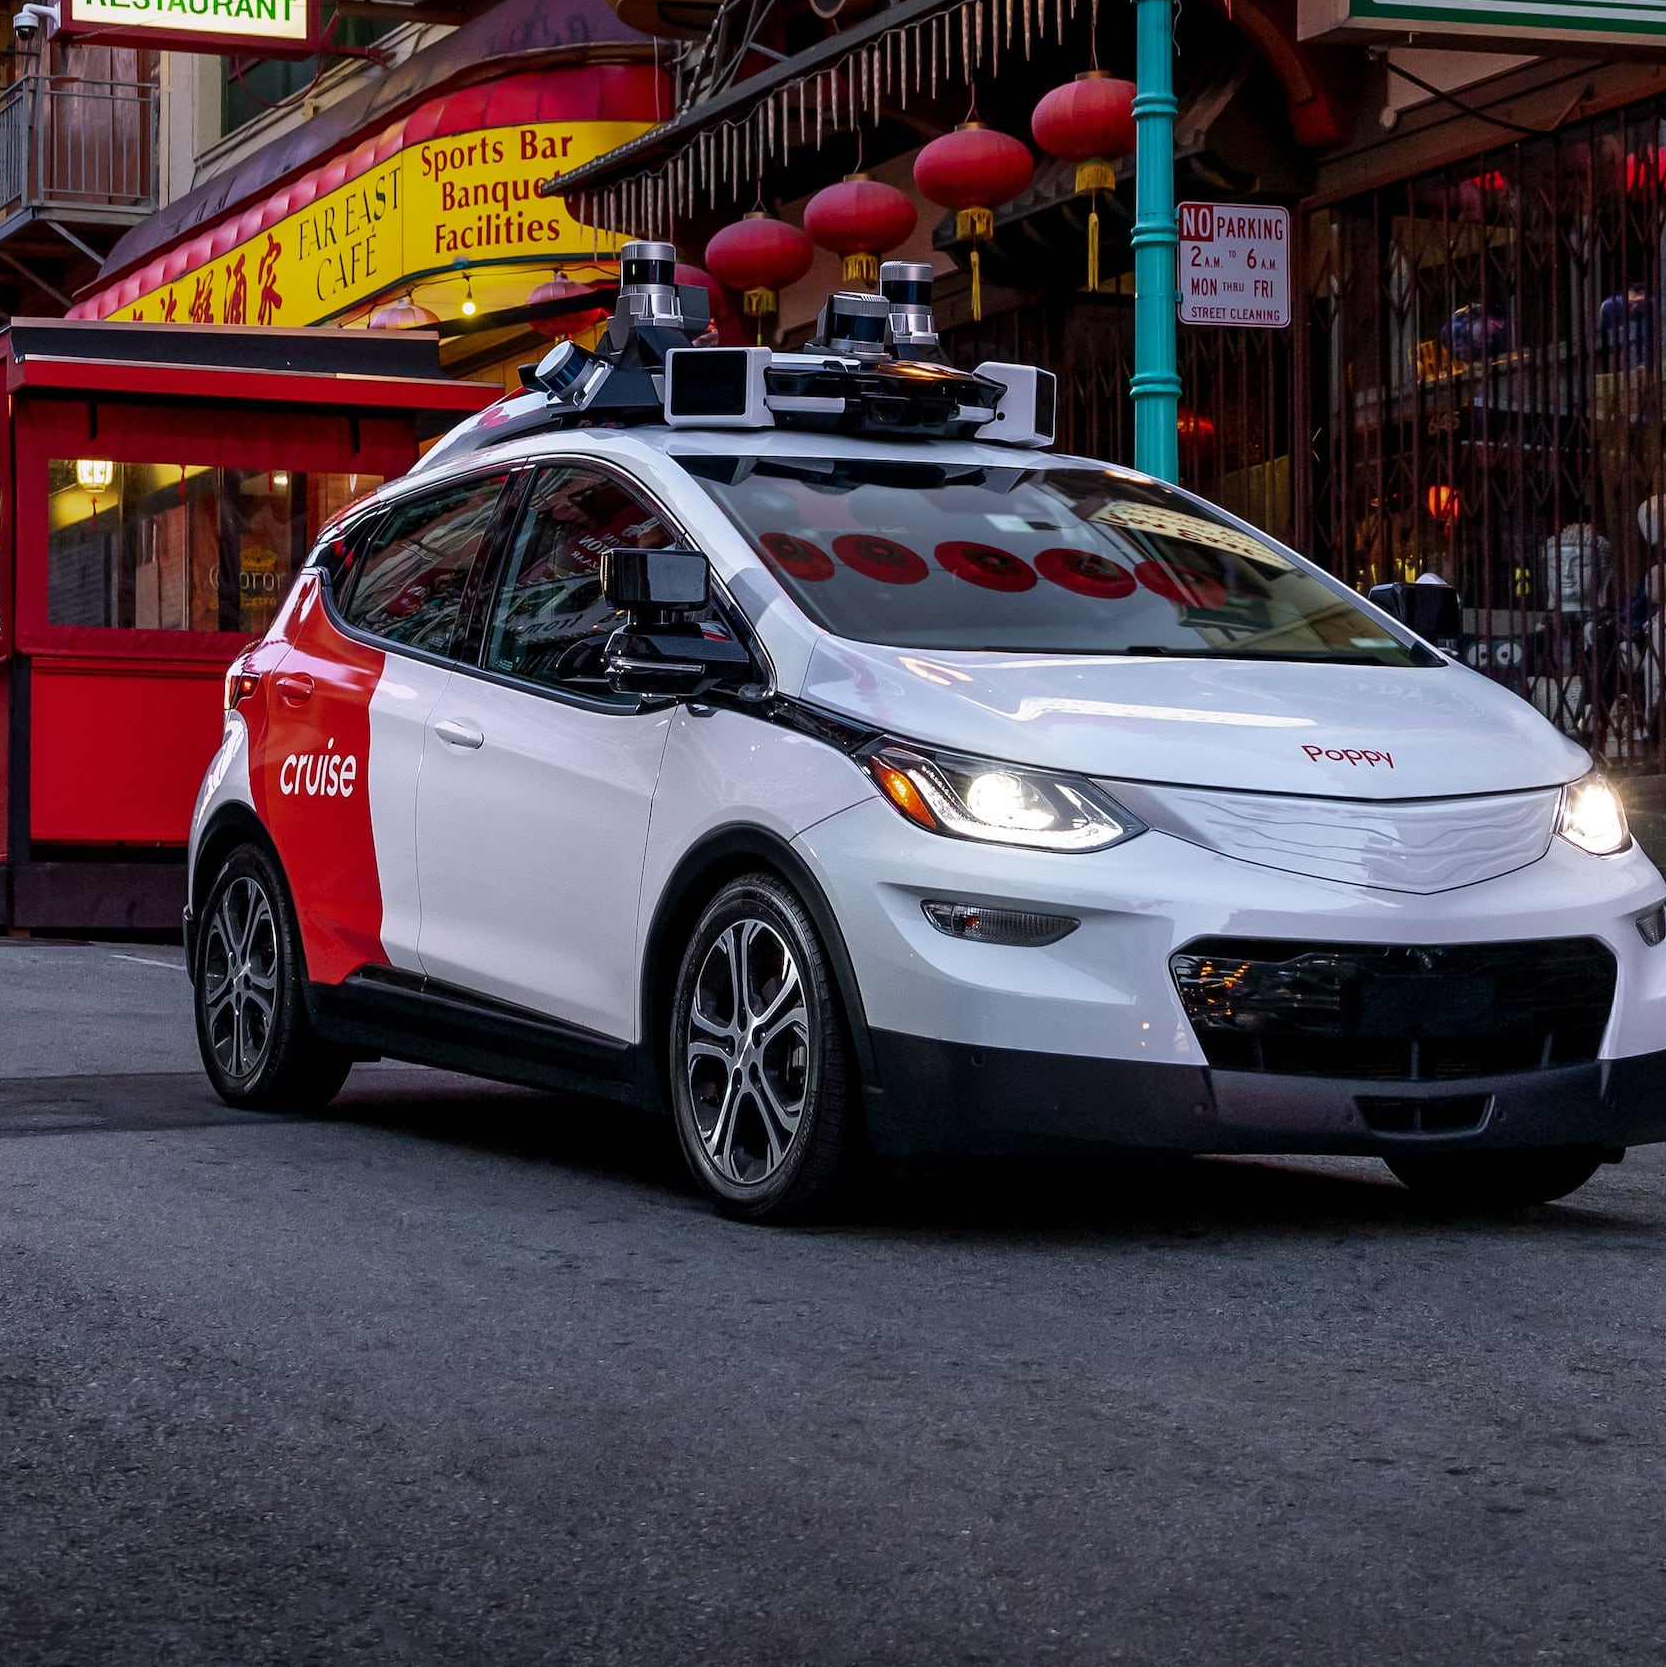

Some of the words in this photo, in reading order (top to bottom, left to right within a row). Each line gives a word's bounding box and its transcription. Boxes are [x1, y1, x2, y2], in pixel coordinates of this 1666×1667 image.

[421, 136, 504, 179] Sports
[519, 129, 575, 160] Bar
[441, 171, 561, 212] Banque
[297, 212, 337, 261] FAR
[343, 166, 404, 238] EAST
[435, 211, 561, 254] Facilities
[1183, 207, 1211, 237] NO
[1217, 216, 1283, 241] PARKING
[315, 231, 378, 302] CAFÉ
[1190, 245, 1202, 267] 2
[1204, 256, 1223, 268] A.M.
[1246, 248, 1257, 269] 6
[1261, 259, 1278, 271] A.M.
[1191, 278, 1217, 296] MON
[1223, 282, 1244, 293] THRU
[1254, 280, 1274, 298] FRI
[1191, 306, 1226, 320] STREET
[1230, 308, 1280, 322] CLEANING
[280, 737, 357, 797] cruise
[1301, 745, 1394, 769] Poppy
